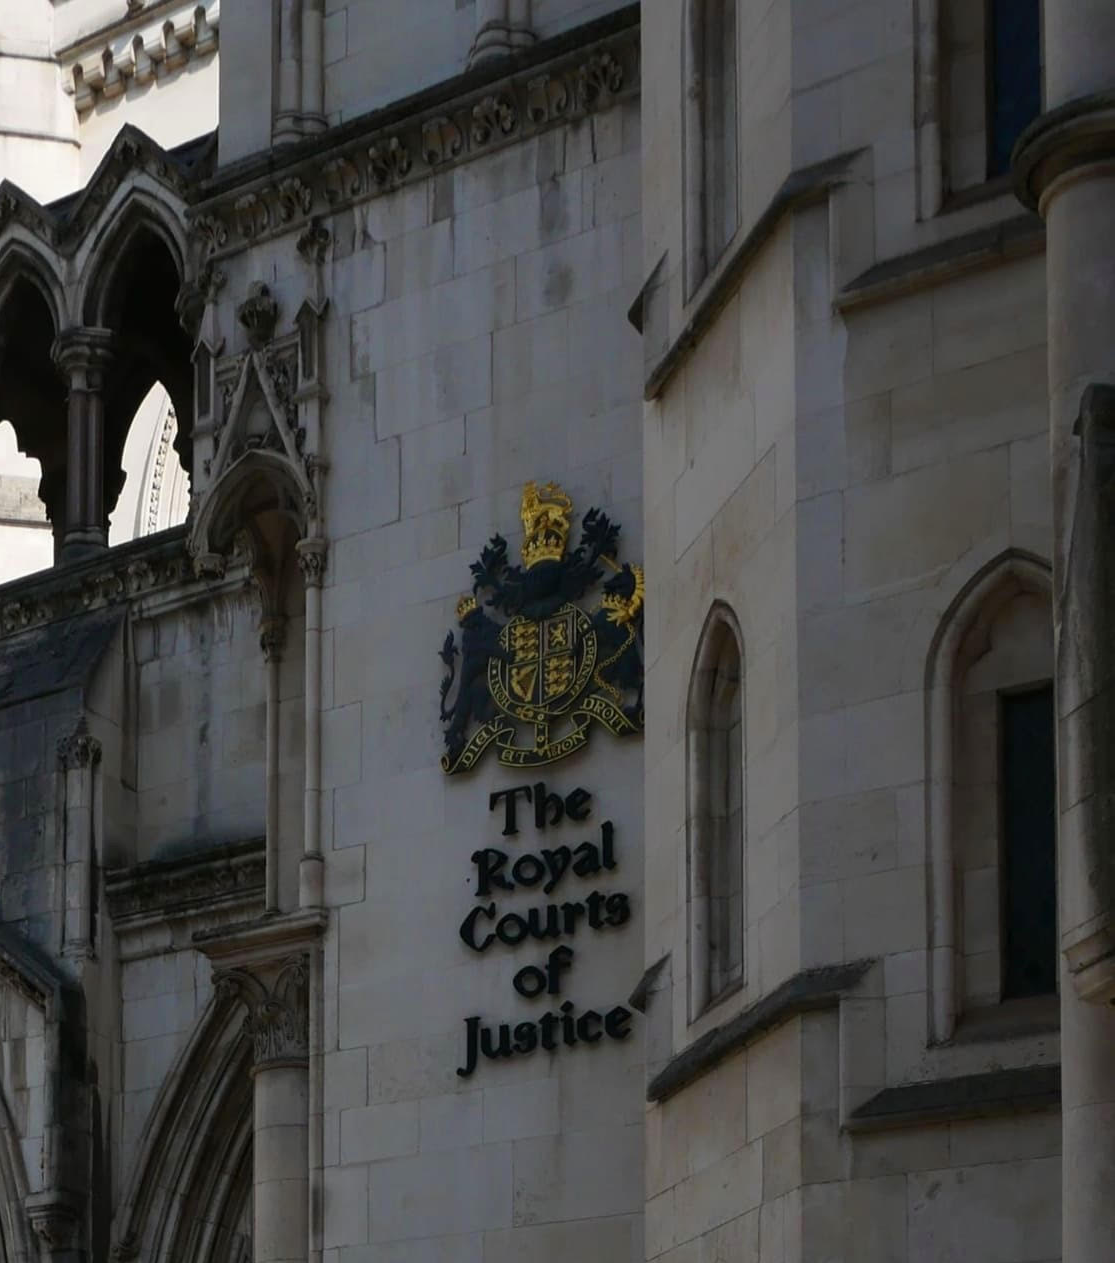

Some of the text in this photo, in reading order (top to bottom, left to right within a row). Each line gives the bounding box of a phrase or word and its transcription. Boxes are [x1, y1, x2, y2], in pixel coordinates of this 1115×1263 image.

[582, 697, 629, 732] DROIT
[488, 781, 593, 837] The
[471, 821, 619, 898] Royal
[459, 889, 633, 953] Courts
[513, 944, 576, 999] of
[456, 999, 634, 1078] Justice
